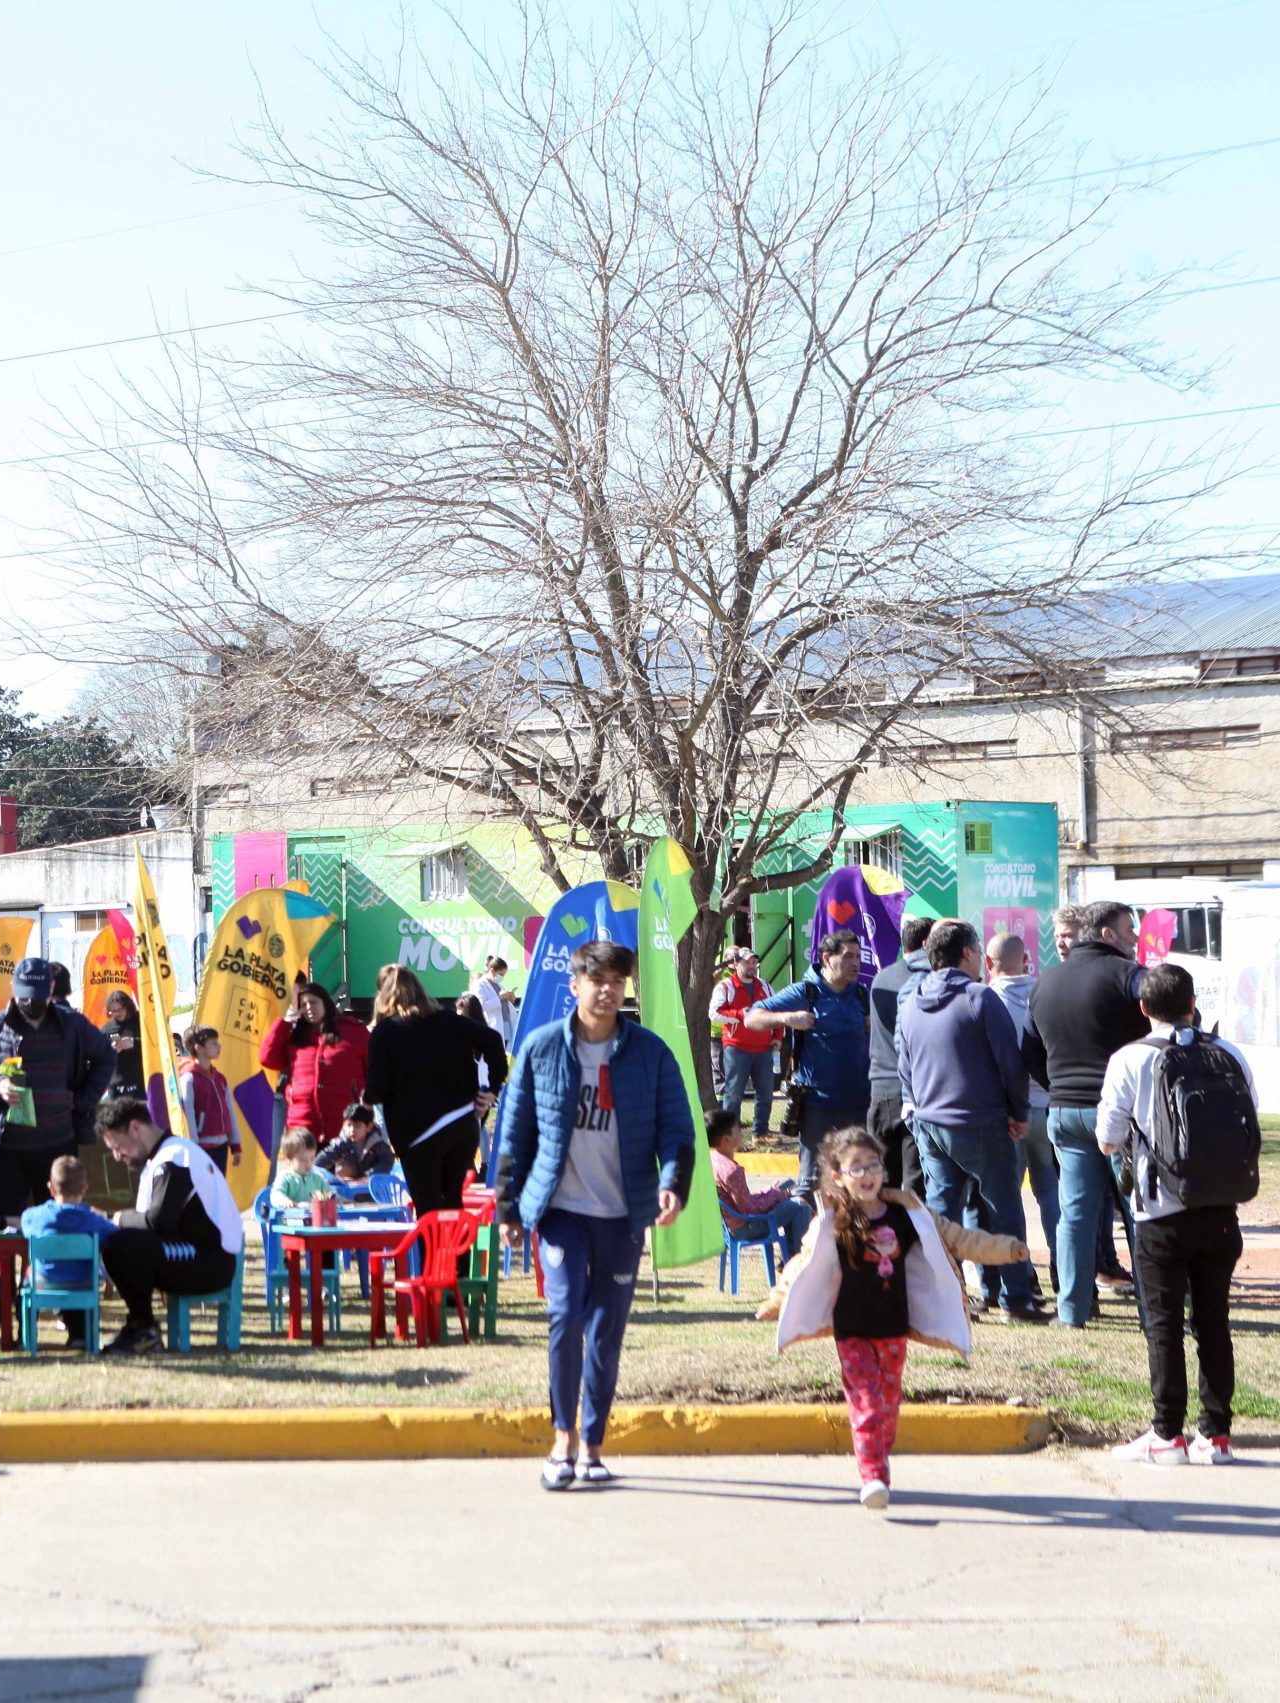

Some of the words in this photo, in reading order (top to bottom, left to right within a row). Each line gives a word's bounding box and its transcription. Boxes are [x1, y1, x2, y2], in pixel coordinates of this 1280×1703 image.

[984, 863, 1036, 874] CONSULTORIO
[398, 917, 517, 935] CONSULTORIO
[547, 943, 570, 960] LA
[223, 944, 245, 961] LA
[250, 951, 287, 986] PLATA
[92, 970, 101, 978] LA
[217, 958, 287, 1000] GOBIERNO
